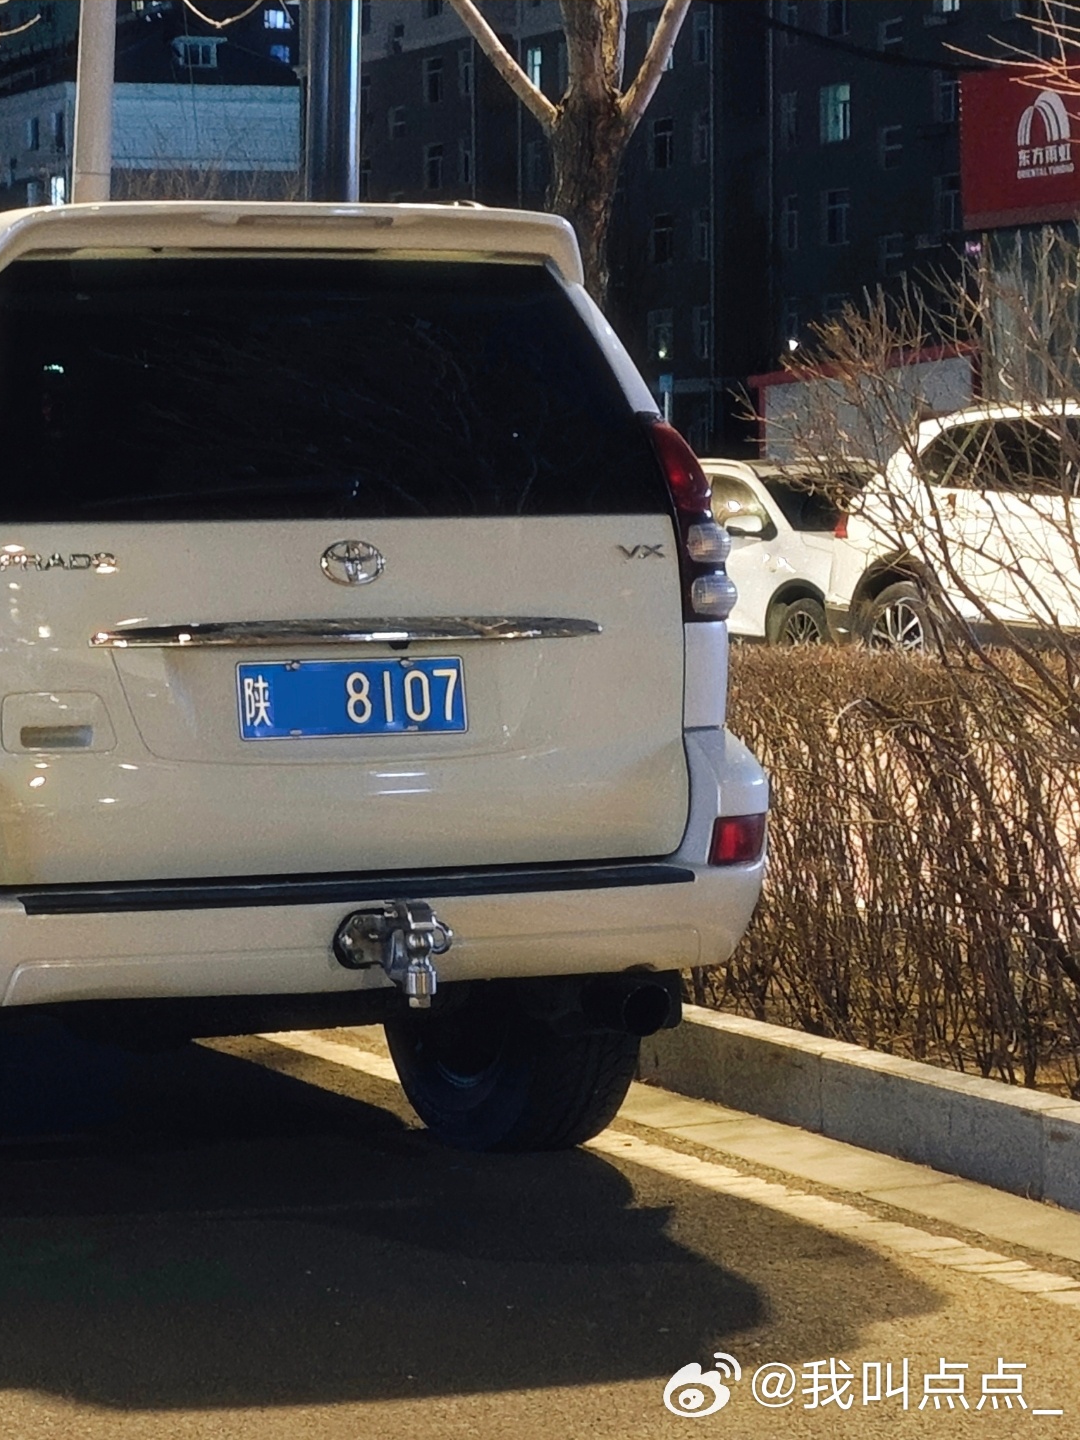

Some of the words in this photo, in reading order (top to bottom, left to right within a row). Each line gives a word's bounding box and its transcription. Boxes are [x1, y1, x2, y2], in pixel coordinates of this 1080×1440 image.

[1018, 143, 1071, 166] 东方雨虹
[0, 551, 117, 572] PRADO
[616, 543, 665, 559] VX
[346, 668, 458, 724] 8107
